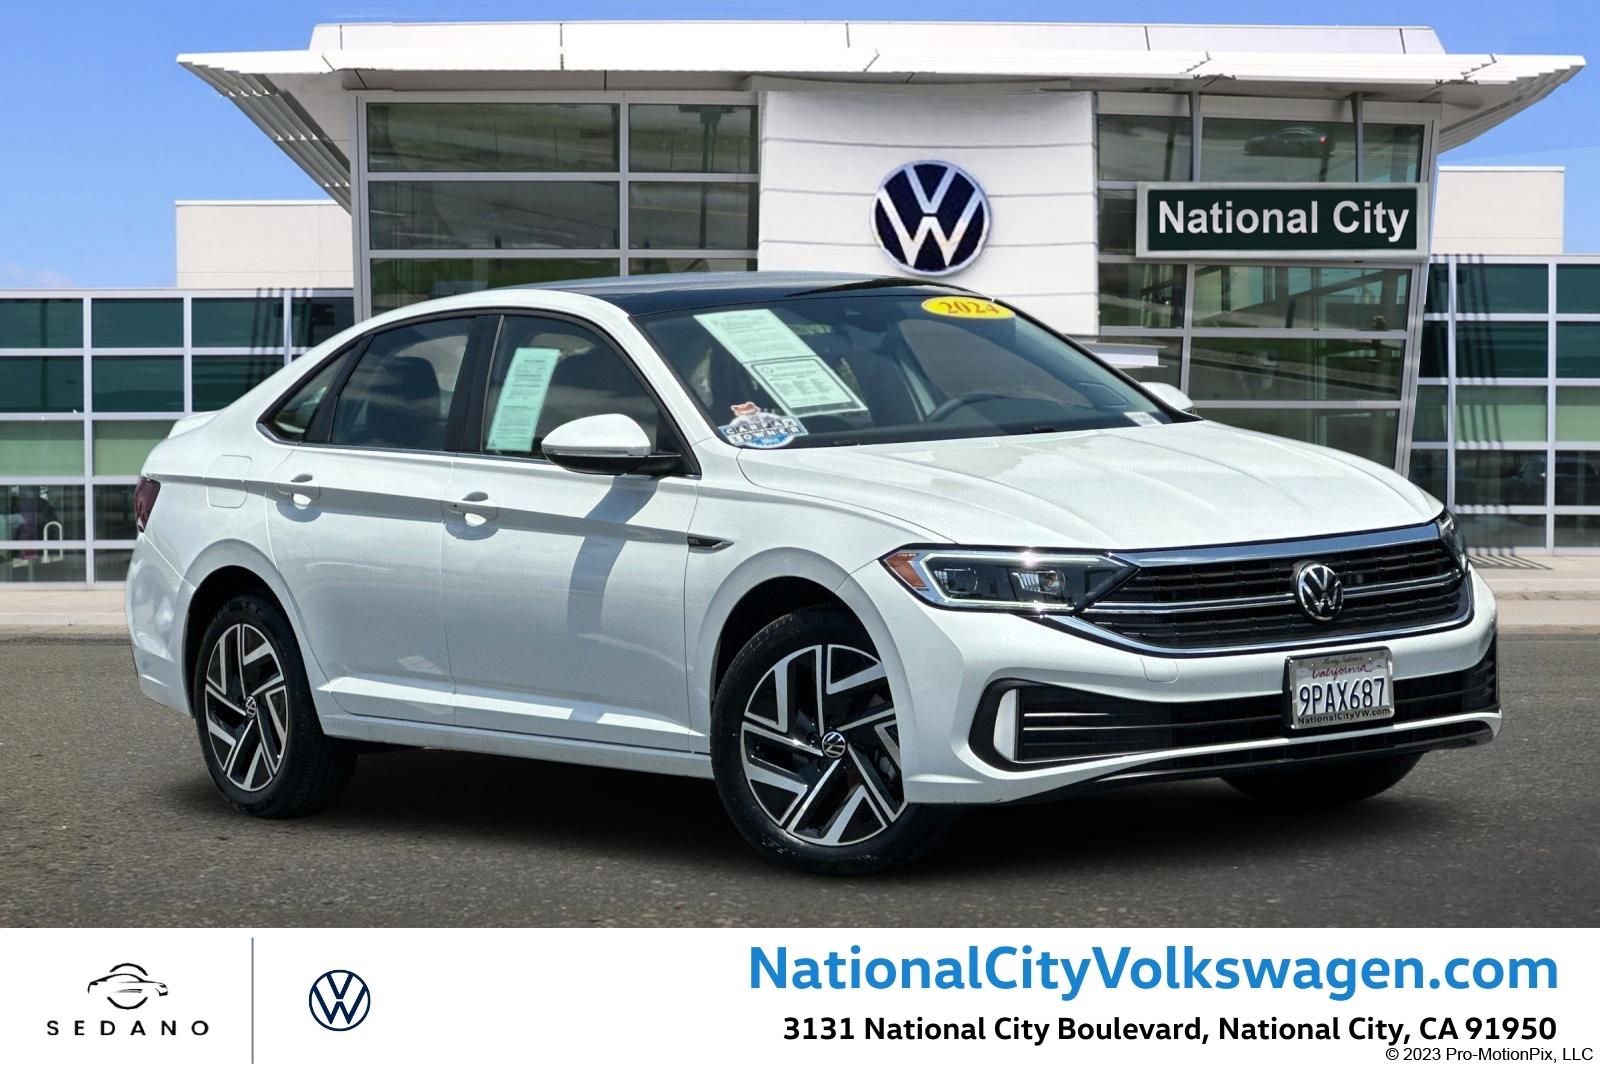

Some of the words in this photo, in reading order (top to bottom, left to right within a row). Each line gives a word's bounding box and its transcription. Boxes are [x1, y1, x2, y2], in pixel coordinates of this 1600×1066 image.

[1159, 200, 1318, 234] National
[1333, 200, 1411, 243] City
[1299, 678, 1385, 716] 9PAX687
[1297, 708, 1391, 726] NationalCityVW.com
